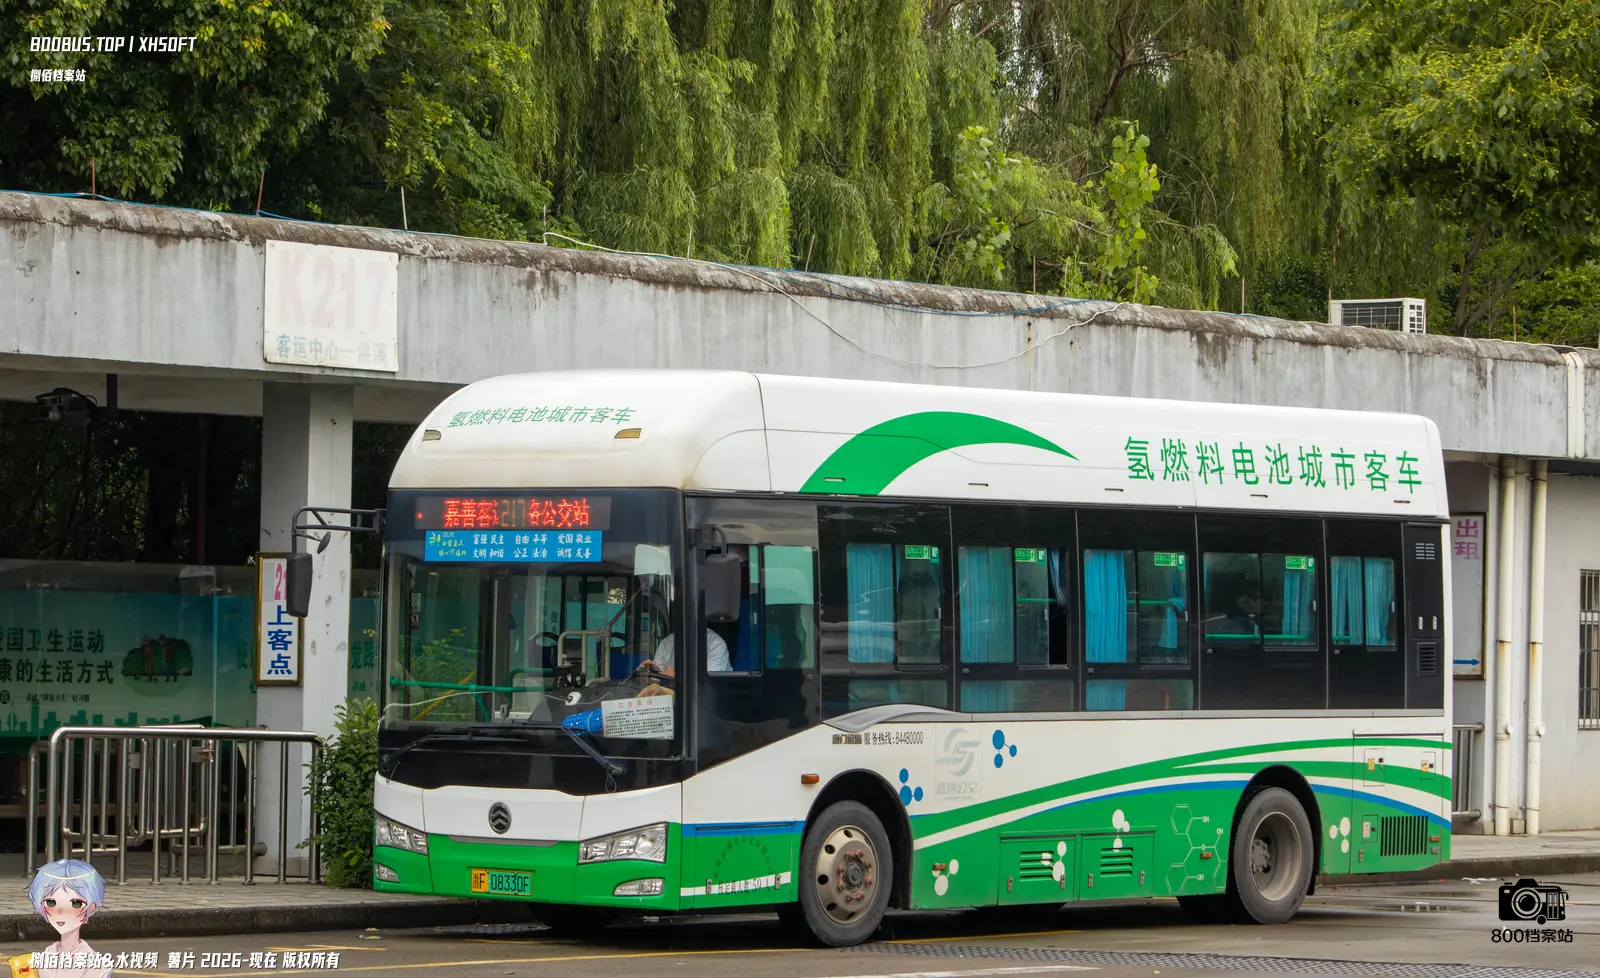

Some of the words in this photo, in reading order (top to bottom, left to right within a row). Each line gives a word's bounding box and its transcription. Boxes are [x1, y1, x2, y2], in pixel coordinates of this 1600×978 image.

[278, 250, 388, 333] K217
[447, 406, 636, 428] 氢燃料电池城市客车
[1124, 435, 1423, 494] 氢燃料电池城市客车
[501, 499, 526, 528] 217
[513, 549, 529, 559] 公正
[515, 534, 530, 545] 自由
[1455, 519, 1479, 560] 出租
[267, 605, 293, 675] 上客点
